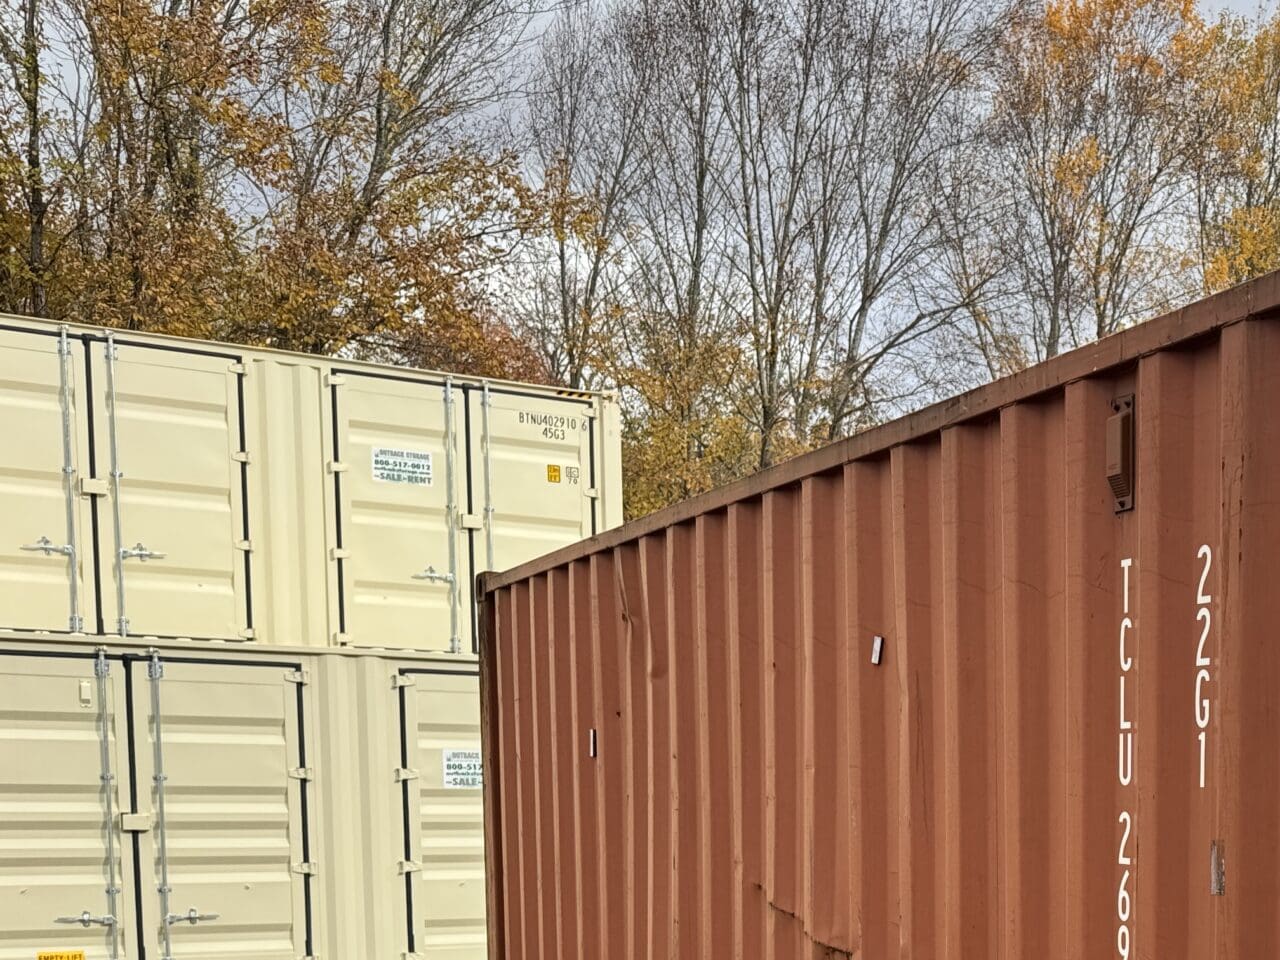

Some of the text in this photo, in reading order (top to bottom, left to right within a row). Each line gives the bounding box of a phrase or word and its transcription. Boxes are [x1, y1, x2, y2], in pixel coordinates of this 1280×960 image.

[542, 427, 565, 440] 45G3
[1118, 558, 1132, 786] TCLU
[1195, 544, 1212, 788] 22G1
